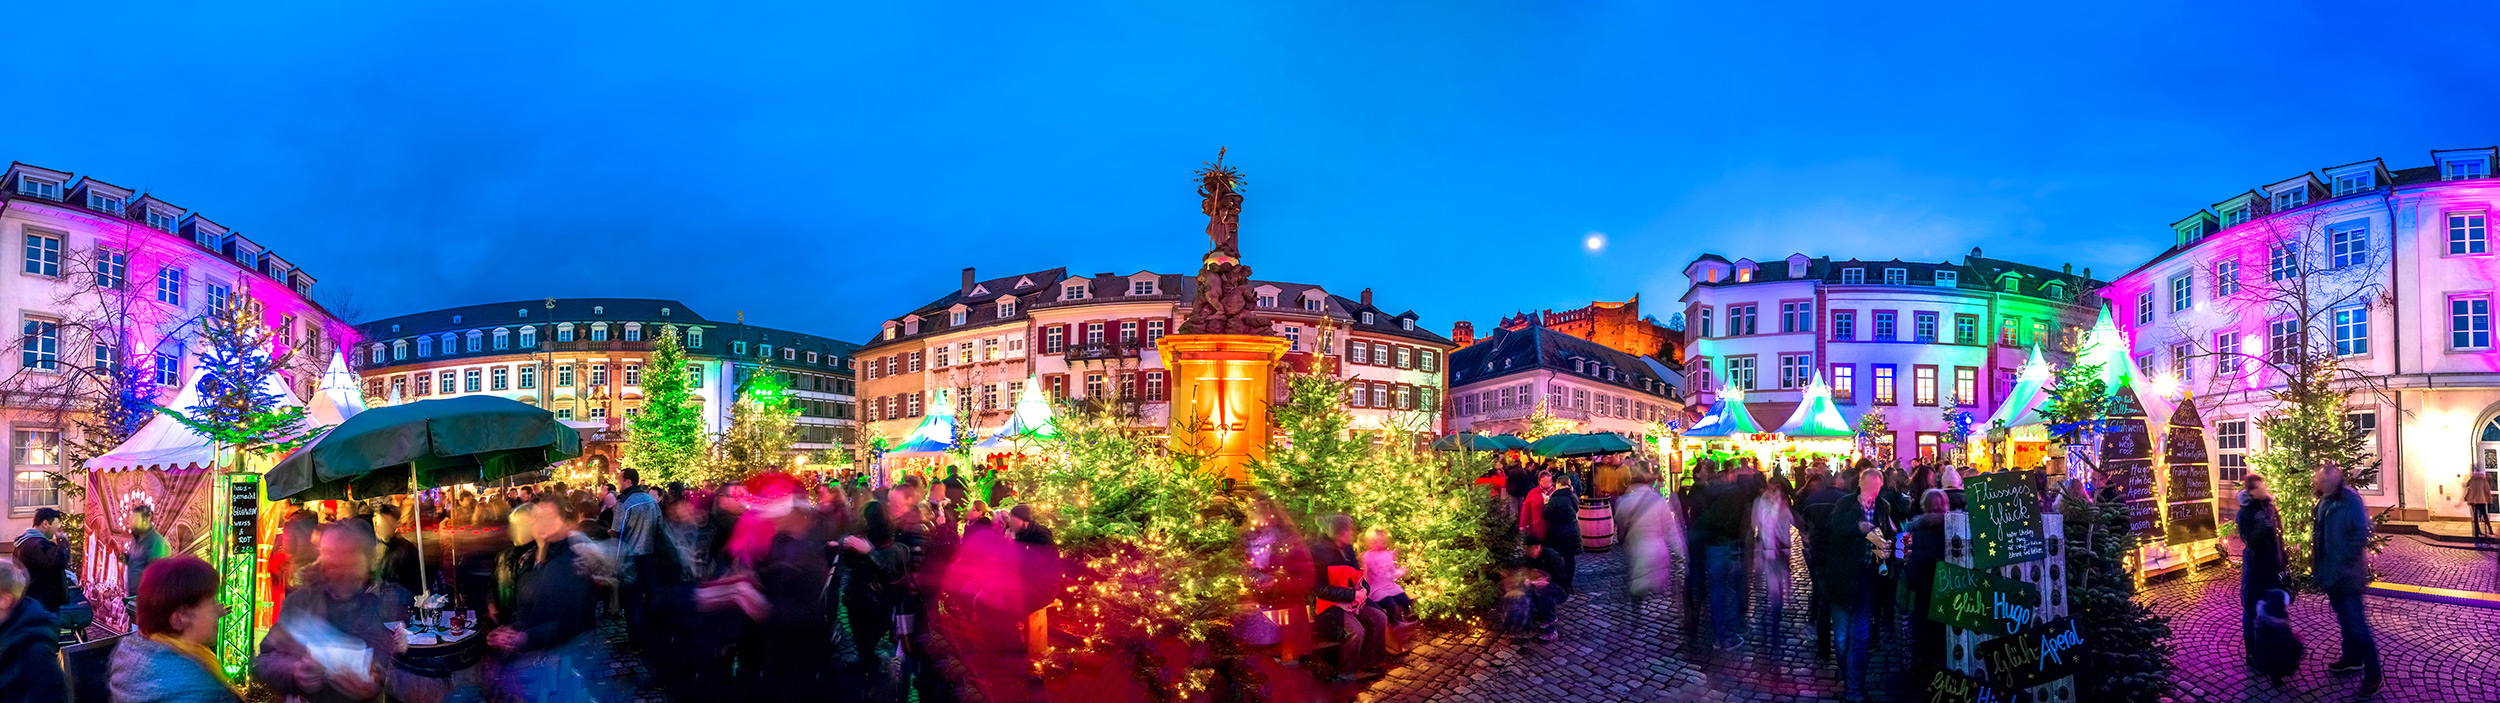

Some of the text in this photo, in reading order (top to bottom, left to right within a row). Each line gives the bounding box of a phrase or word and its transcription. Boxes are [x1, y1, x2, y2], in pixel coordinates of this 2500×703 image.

[2130, 463, 2151, 477] Hugo
[2127, 485, 2153, 498] Aperol
[2170, 505, 2191, 519] Fritz
[1937, 567, 1978, 592] Black
[1993, 591, 2030, 634] Hugo
[2039, 619, 2084, 671] Aperol
